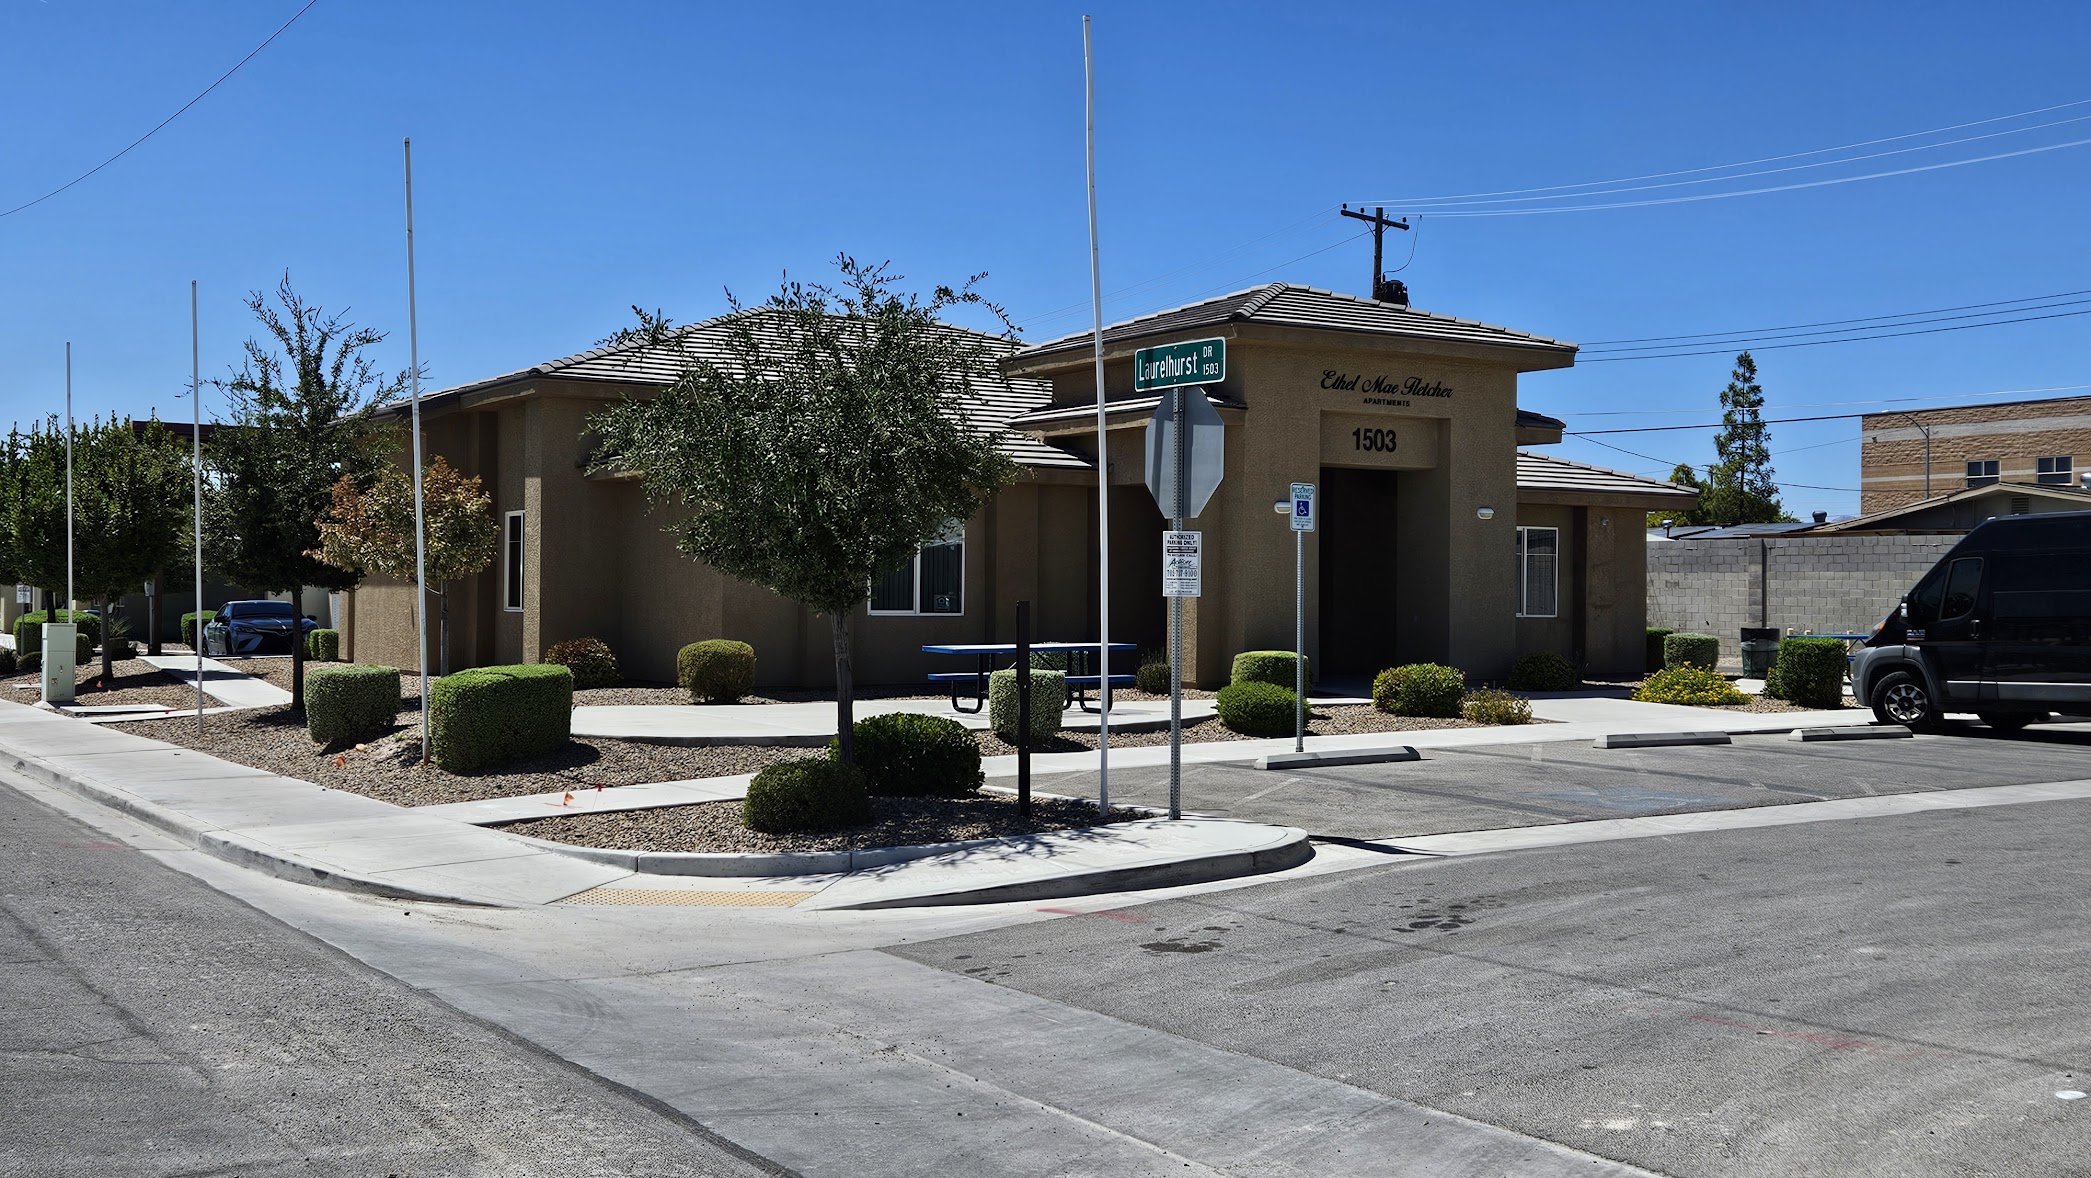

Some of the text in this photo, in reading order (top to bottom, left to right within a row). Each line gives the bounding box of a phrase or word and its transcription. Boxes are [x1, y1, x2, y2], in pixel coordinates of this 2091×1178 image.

[1203, 346, 1213, 358] DR
[1139, 351, 1198, 382] Laurelhurst
[1203, 362, 1219, 376] 1503
[1320, 370, 1454, 398] Ethel Mae Fletcher
[1363, 397, 1410, 407] APARTMENTS
[1353, 428, 1397, 453] 1503
